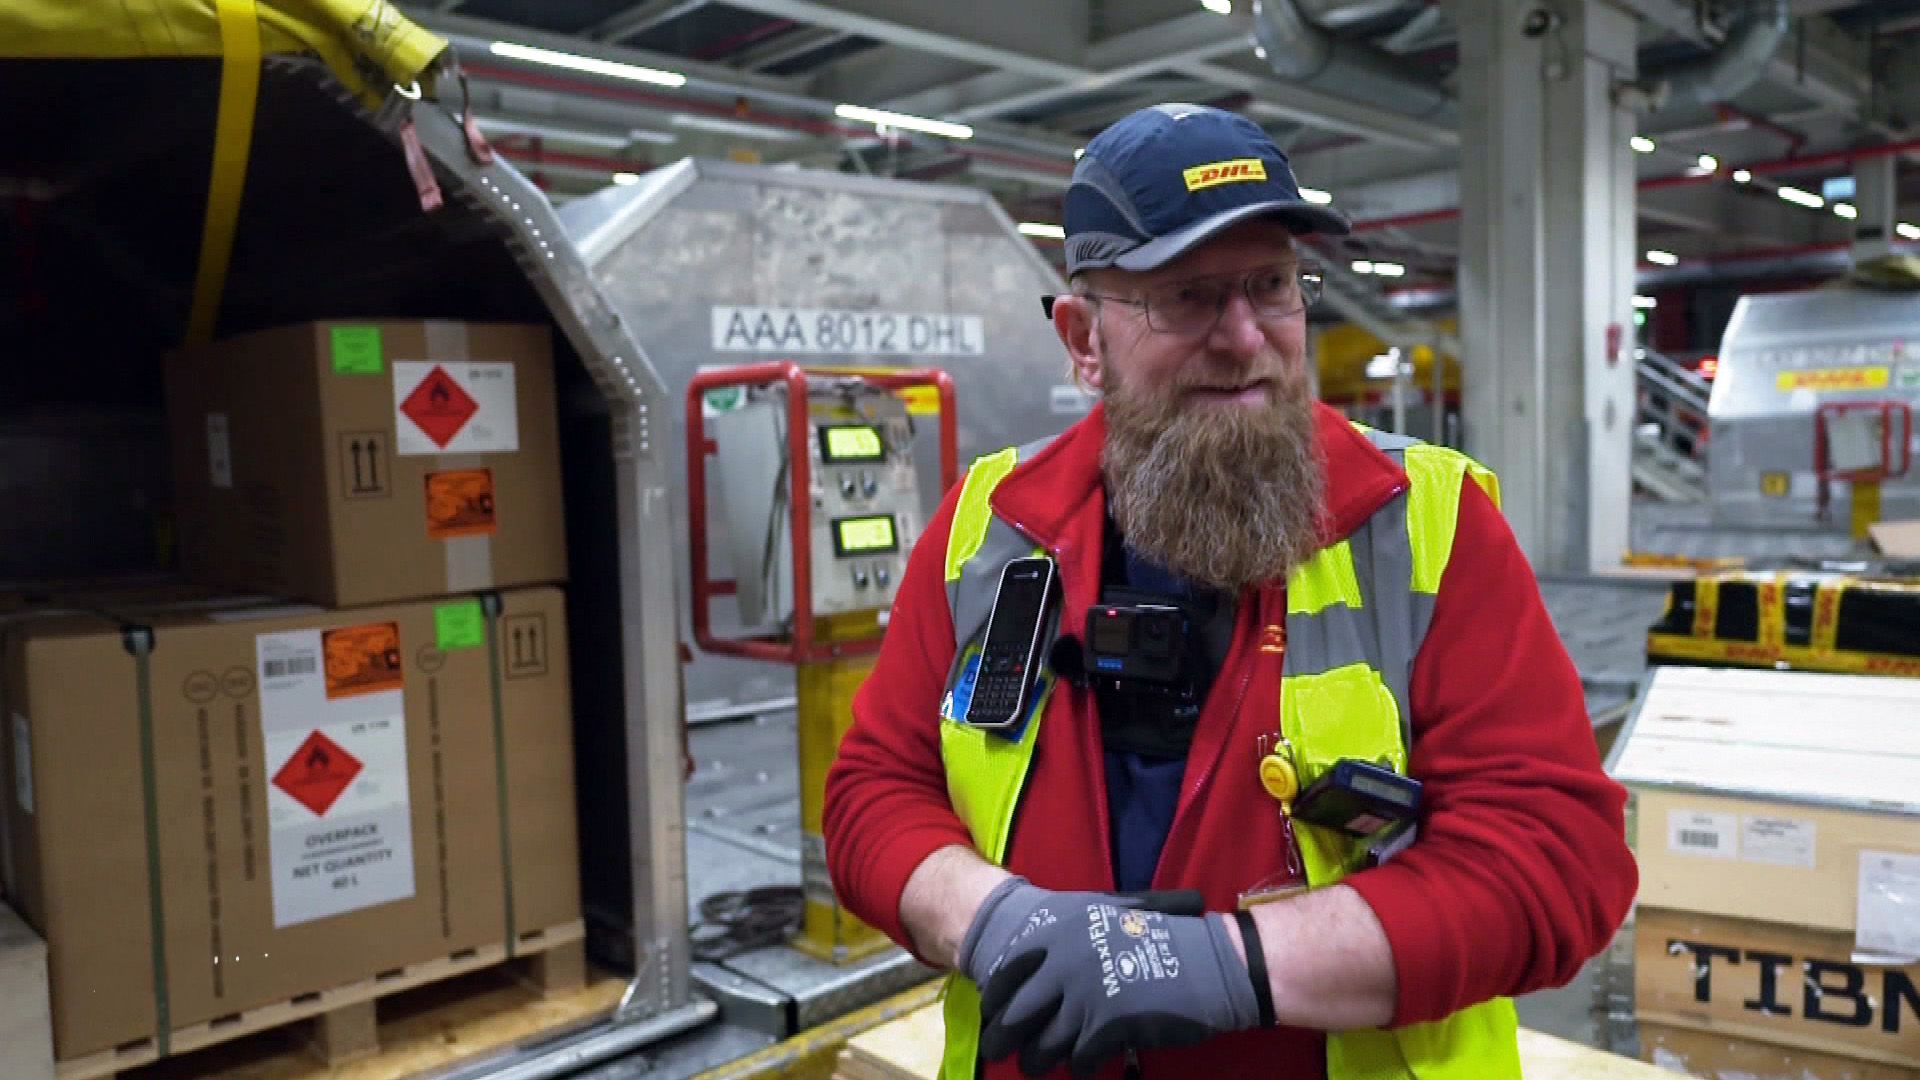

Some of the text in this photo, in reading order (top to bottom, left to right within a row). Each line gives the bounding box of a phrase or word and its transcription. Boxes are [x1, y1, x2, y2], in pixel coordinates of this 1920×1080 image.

[1200, 165, 1251, 183] DHL
[725, 312, 976, 350] AAA 8012 DHL
[304, 823, 378, 847] OVERPACK
[292, 862, 320, 879] NET
[323, 848, 393, 873] QUANTITY
